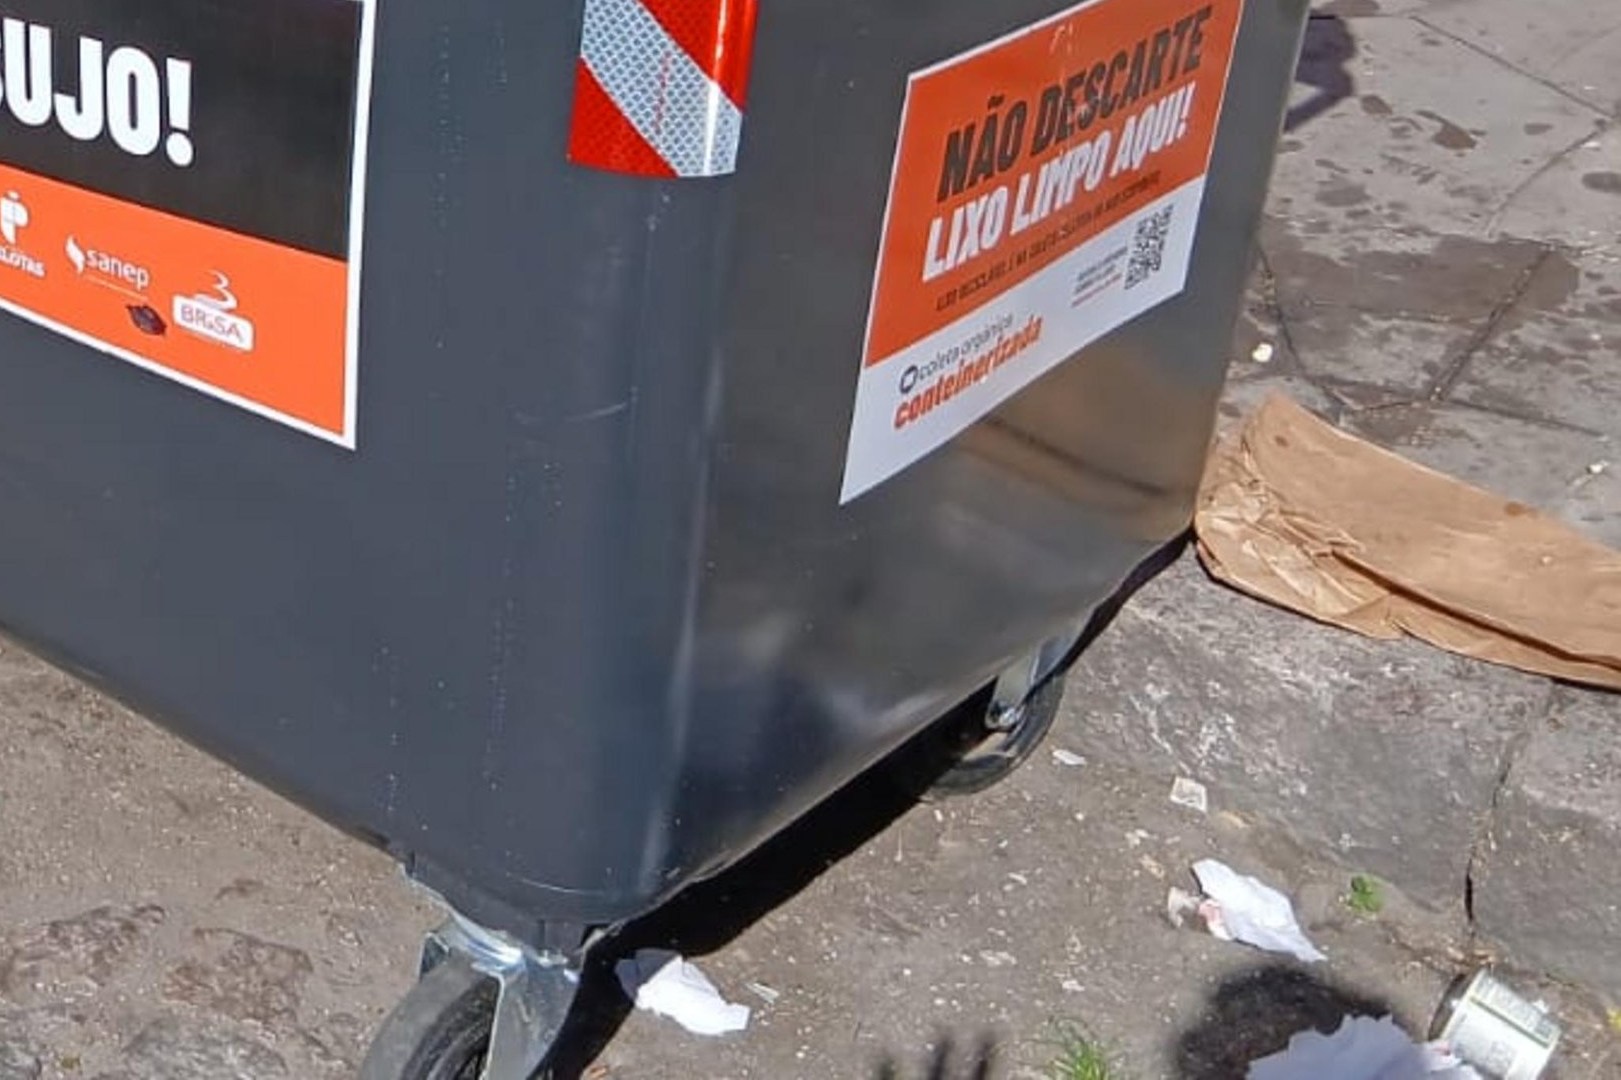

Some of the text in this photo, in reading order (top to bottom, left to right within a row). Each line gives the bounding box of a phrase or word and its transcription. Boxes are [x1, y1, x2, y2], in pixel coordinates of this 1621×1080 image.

[922, 186, 1008, 282] LIXO
[1010, 130, 1111, 236] LIMPO
[1110, 81, 1195, 178] AQUI!
[937, 95, 1027, 203] NÃO
[1030, 5, 1212, 156] DESCARTE
[86, 249, 150, 290] sanep
[894, 314, 1043, 430] conteinerizada
